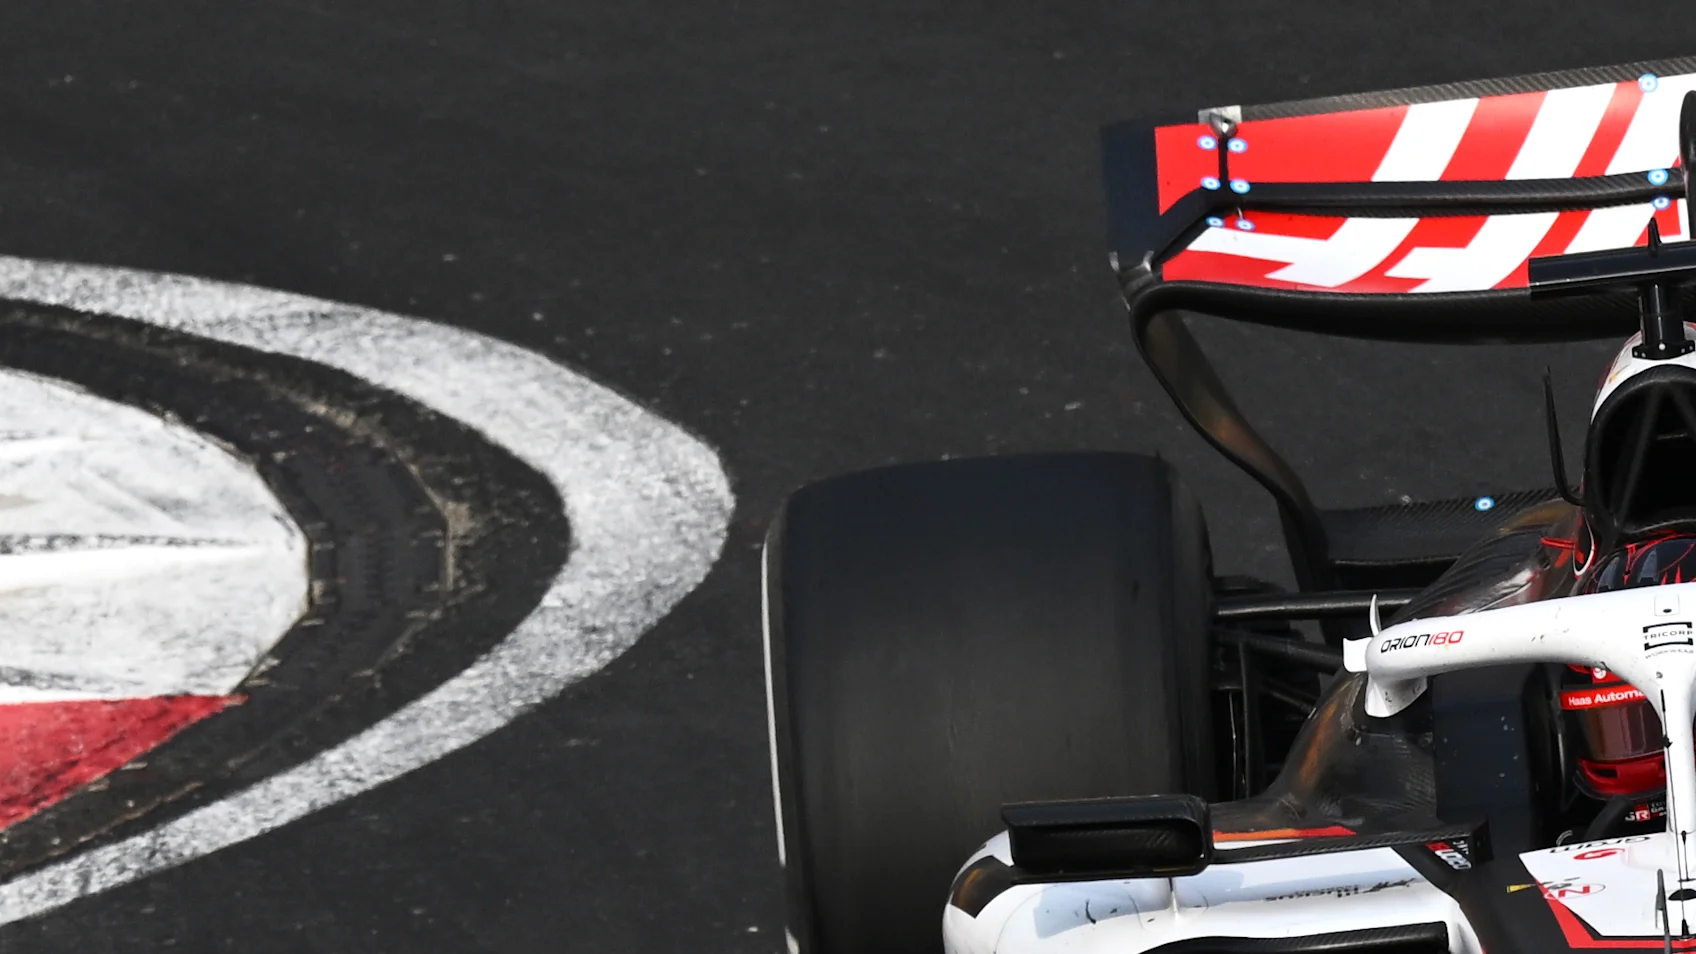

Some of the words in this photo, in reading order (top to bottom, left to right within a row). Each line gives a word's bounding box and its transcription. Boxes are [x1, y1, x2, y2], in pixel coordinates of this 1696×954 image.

[1380, 630, 1465, 653] ORION180
[1643, 629, 1693, 640] TRICORP
[1567, 696, 1592, 706] Haas
[1594, 689, 1644, 704] Automa
